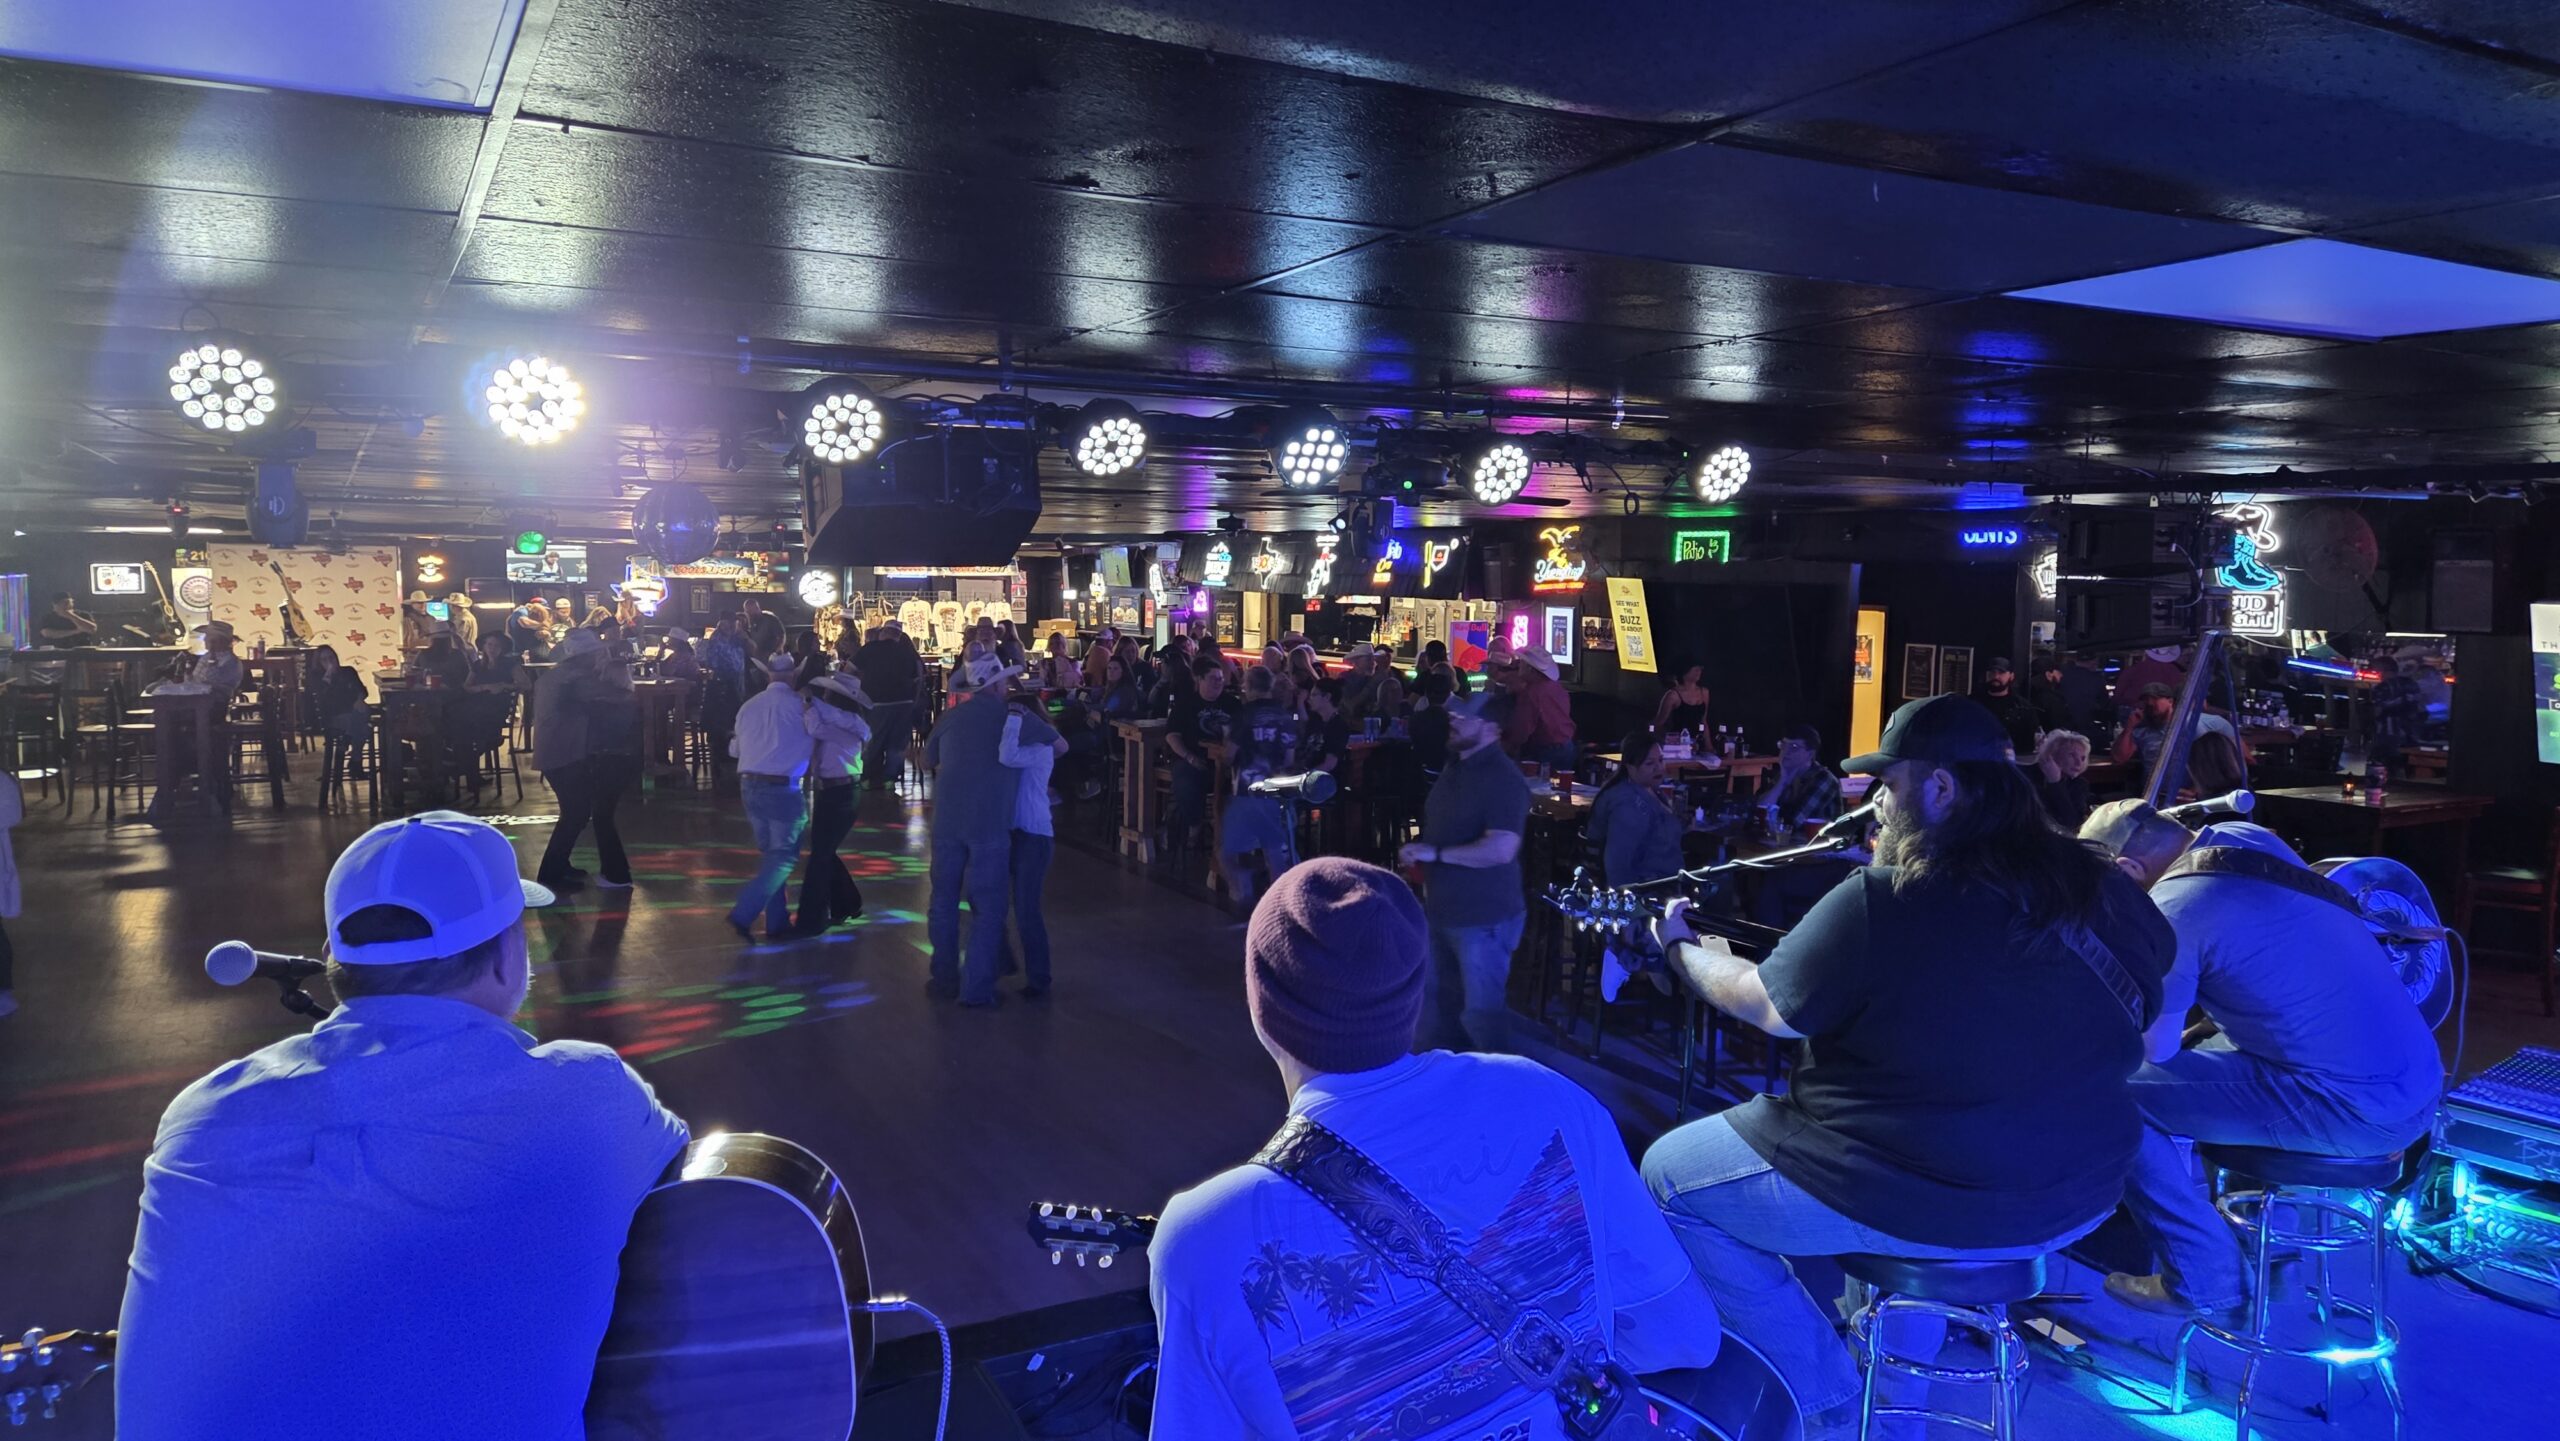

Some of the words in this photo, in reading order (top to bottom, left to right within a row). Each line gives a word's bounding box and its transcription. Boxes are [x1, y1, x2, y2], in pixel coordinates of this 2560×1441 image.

[1683, 540, 1704, 561] Patio
[1620, 615, 1641, 626] BUZZ
[1471, 623, 1487, 632] Bull
